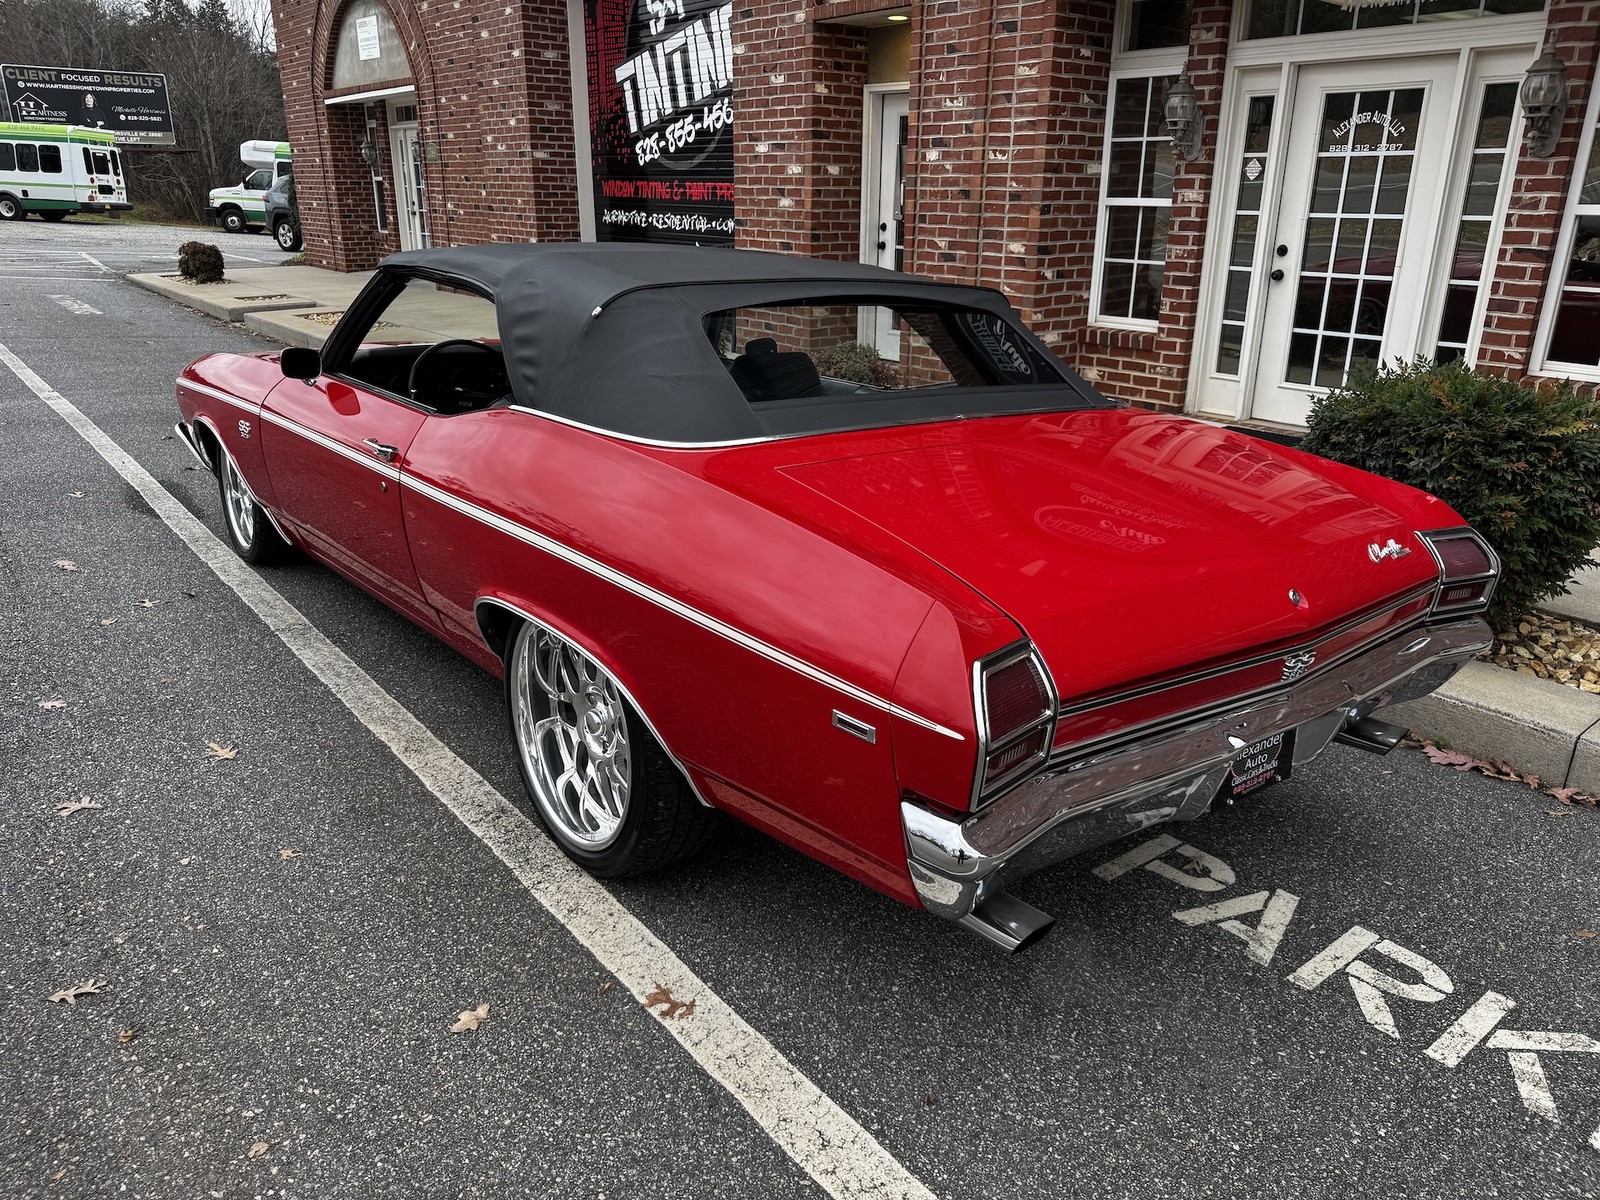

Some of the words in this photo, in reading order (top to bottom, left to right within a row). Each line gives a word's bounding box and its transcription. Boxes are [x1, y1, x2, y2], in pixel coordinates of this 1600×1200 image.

[5, 68, 57, 81] CLIENT
[61, 73, 100, 82] FOCUSED
[104, 74, 162, 87] RESULTS
[1332, 112, 1372, 139] ALEXANDER
[1389, 119, 1405, 137] LLC
[602, 180, 635, 197] WINDOW
[637, 181, 670, 199] TINTING
[673, 180, 684, 201] &
[685, 182, 715, 200] PAINT
[1237, 732, 1284, 761] exander
[1244, 753, 1268, 770] Auto
[1092, 834, 1600, 1152] PARK
